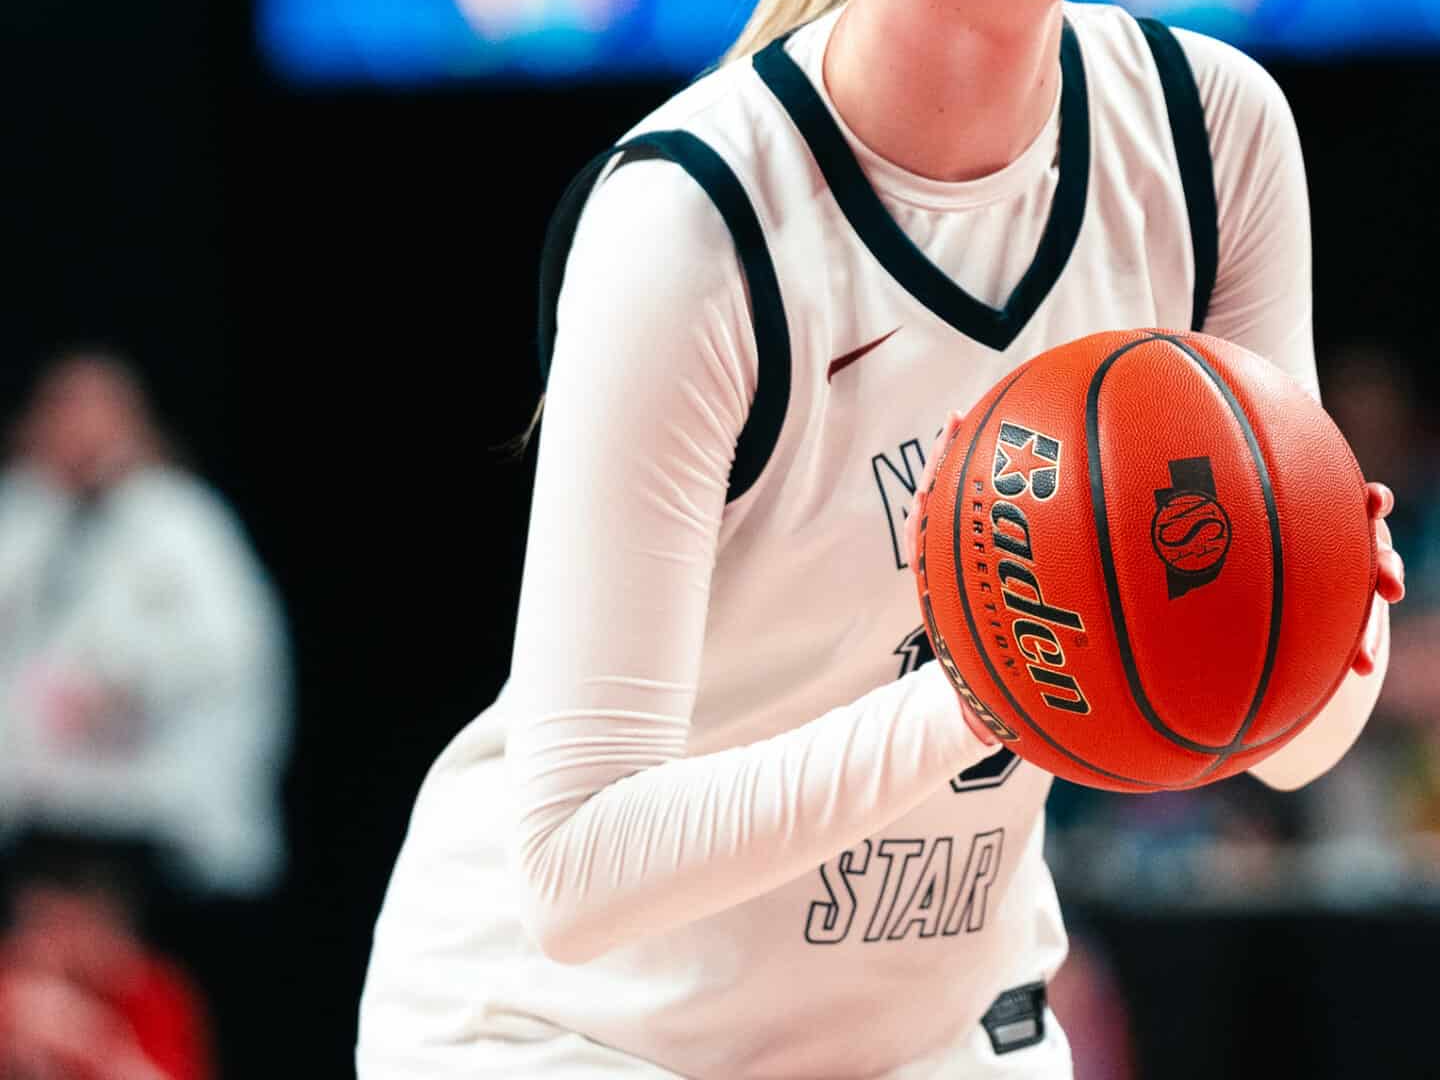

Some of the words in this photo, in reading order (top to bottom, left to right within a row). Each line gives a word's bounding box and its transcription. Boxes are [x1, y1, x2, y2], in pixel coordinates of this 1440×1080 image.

[972, 479, 1015, 668] PERFECTION
[990, 420, 1091, 716] Baden
[804, 827, 1005, 945] STAR
